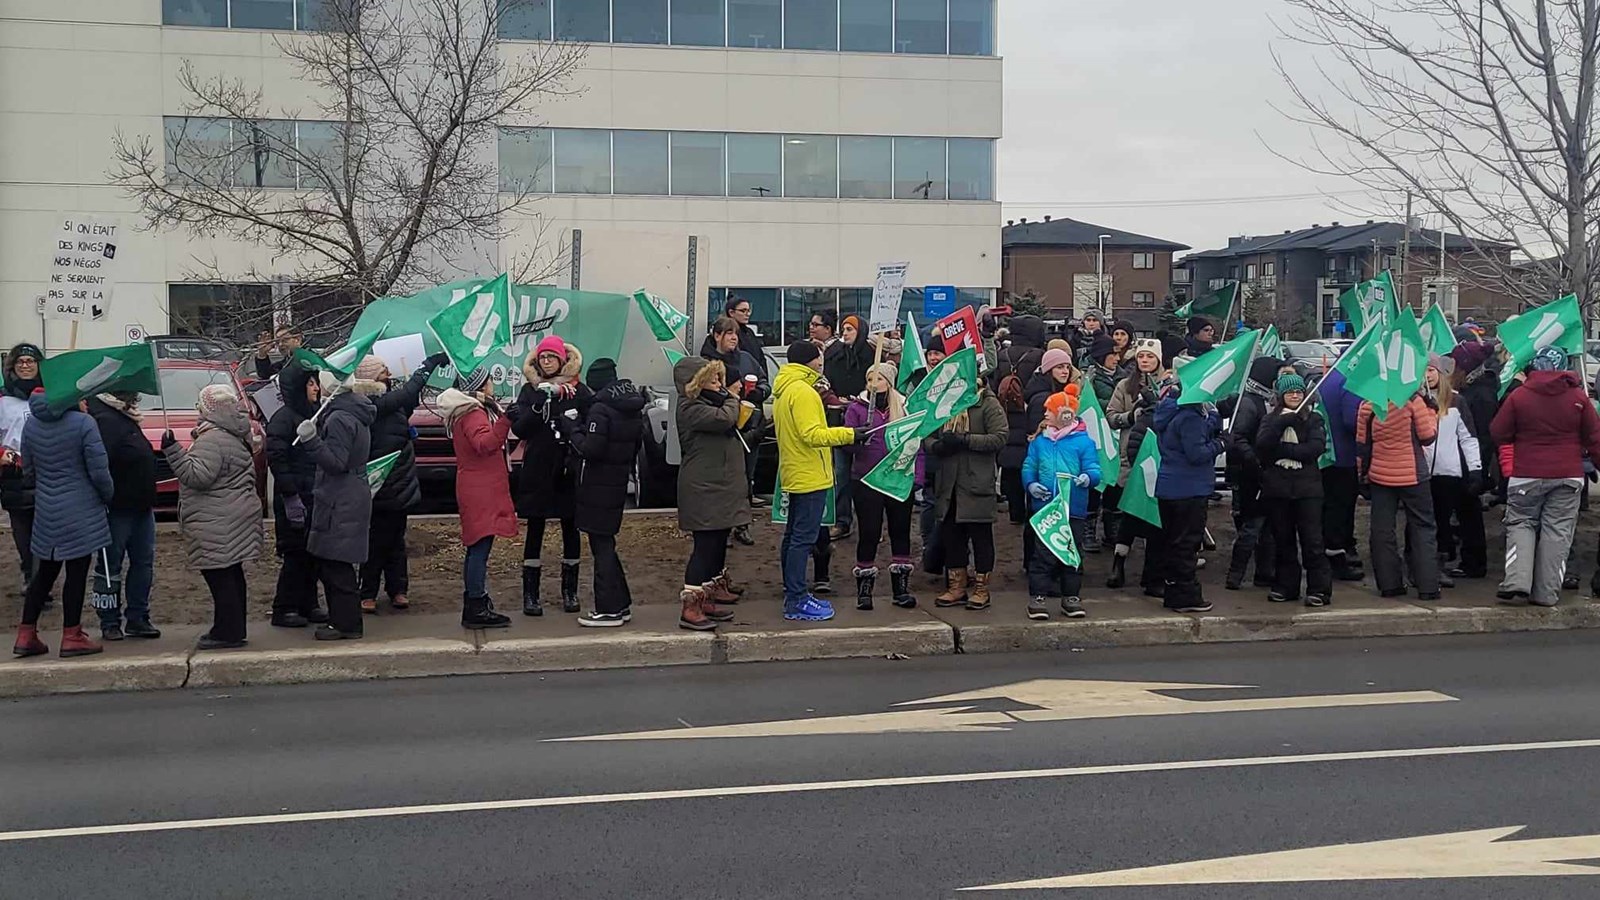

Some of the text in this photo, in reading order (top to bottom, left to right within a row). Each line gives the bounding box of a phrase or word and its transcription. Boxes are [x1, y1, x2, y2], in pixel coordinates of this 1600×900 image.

[63, 220, 117, 236] SI ON ÉTAIT
[58, 240, 103, 252] DES KINGS
[54, 256, 101, 269] NOS NÉGOS
[51, 273, 105, 285] NE SERAIENT
[48, 289, 103, 300] PAS SUR LA
